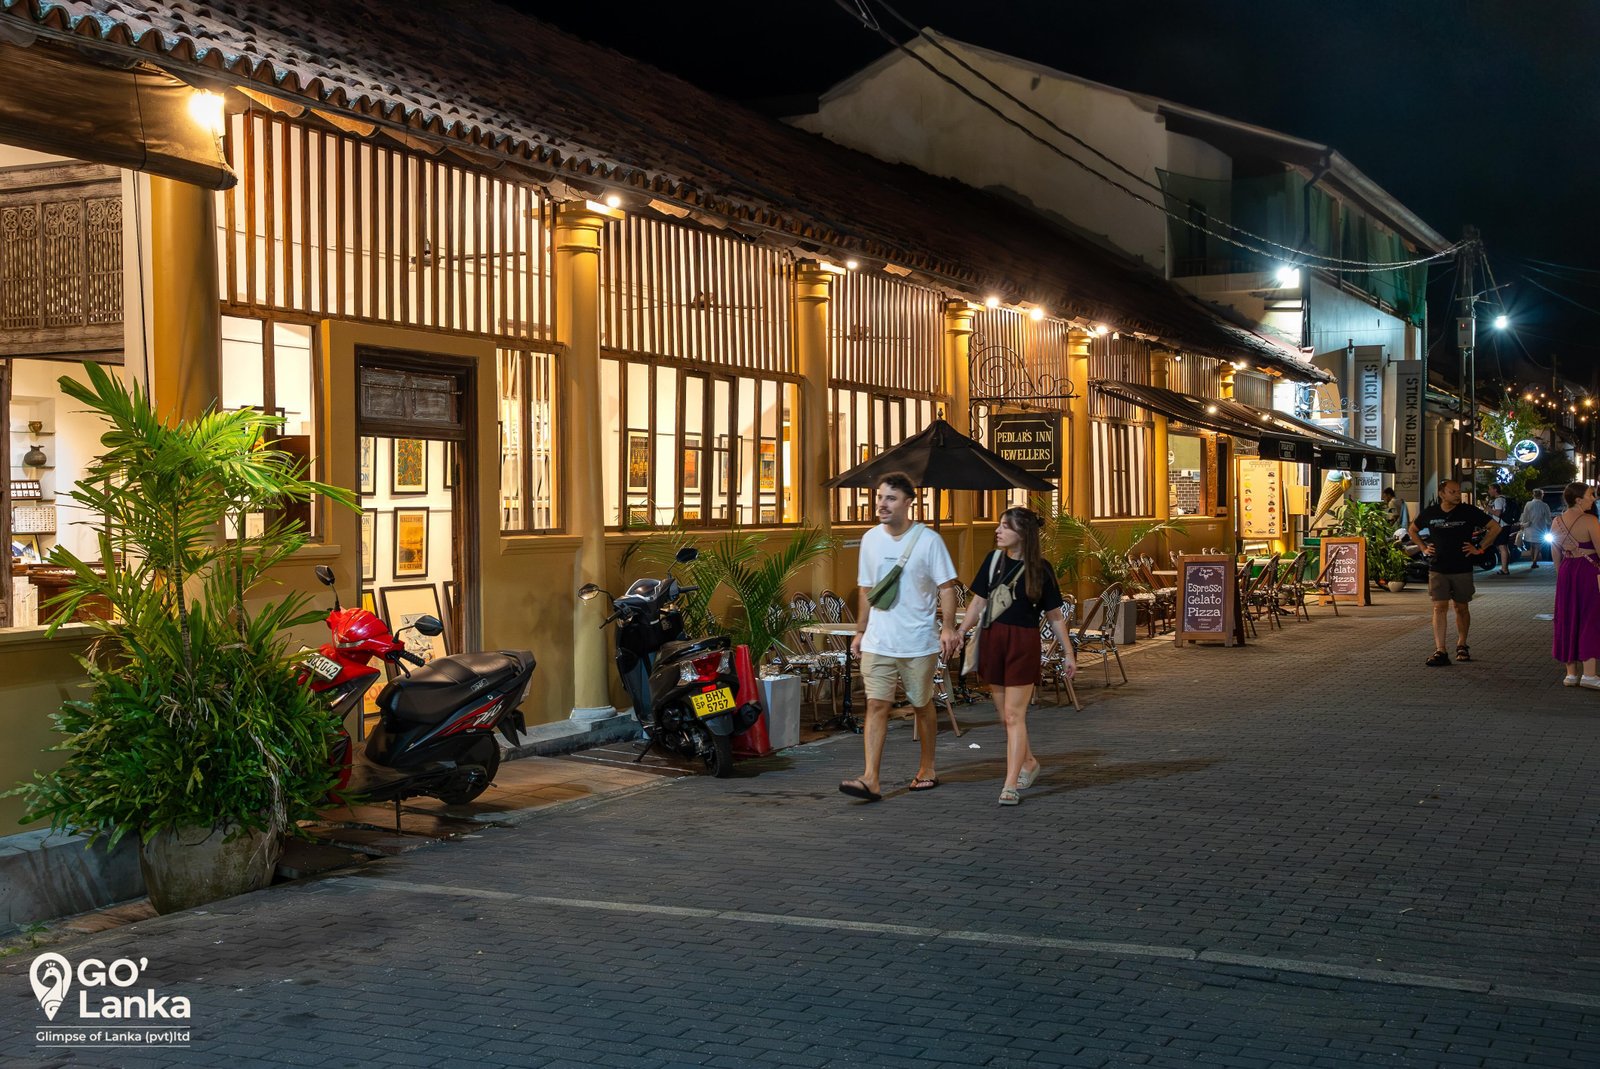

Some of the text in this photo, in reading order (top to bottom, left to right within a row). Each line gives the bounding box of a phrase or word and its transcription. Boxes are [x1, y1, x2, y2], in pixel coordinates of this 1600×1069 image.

[1406, 377, 1418, 410] STICK
[1365, 364, 1378, 448] STICK NO BIL
[1405, 414, 1418, 430] NO
[997, 429, 1052, 443] PEDLAR'S INN
[1405, 433, 1417, 466] BILLS
[1355, 476, 1380, 487] Traveler
[1187, 583, 1222, 596] Espresso
[1187, 594, 1222, 605] Gelato
[1187, 607, 1221, 617] Pizza
[705, 690, 726, 702] BHX
[695, 702, 706, 710] SP
[706, 699, 729, 712] 5757
